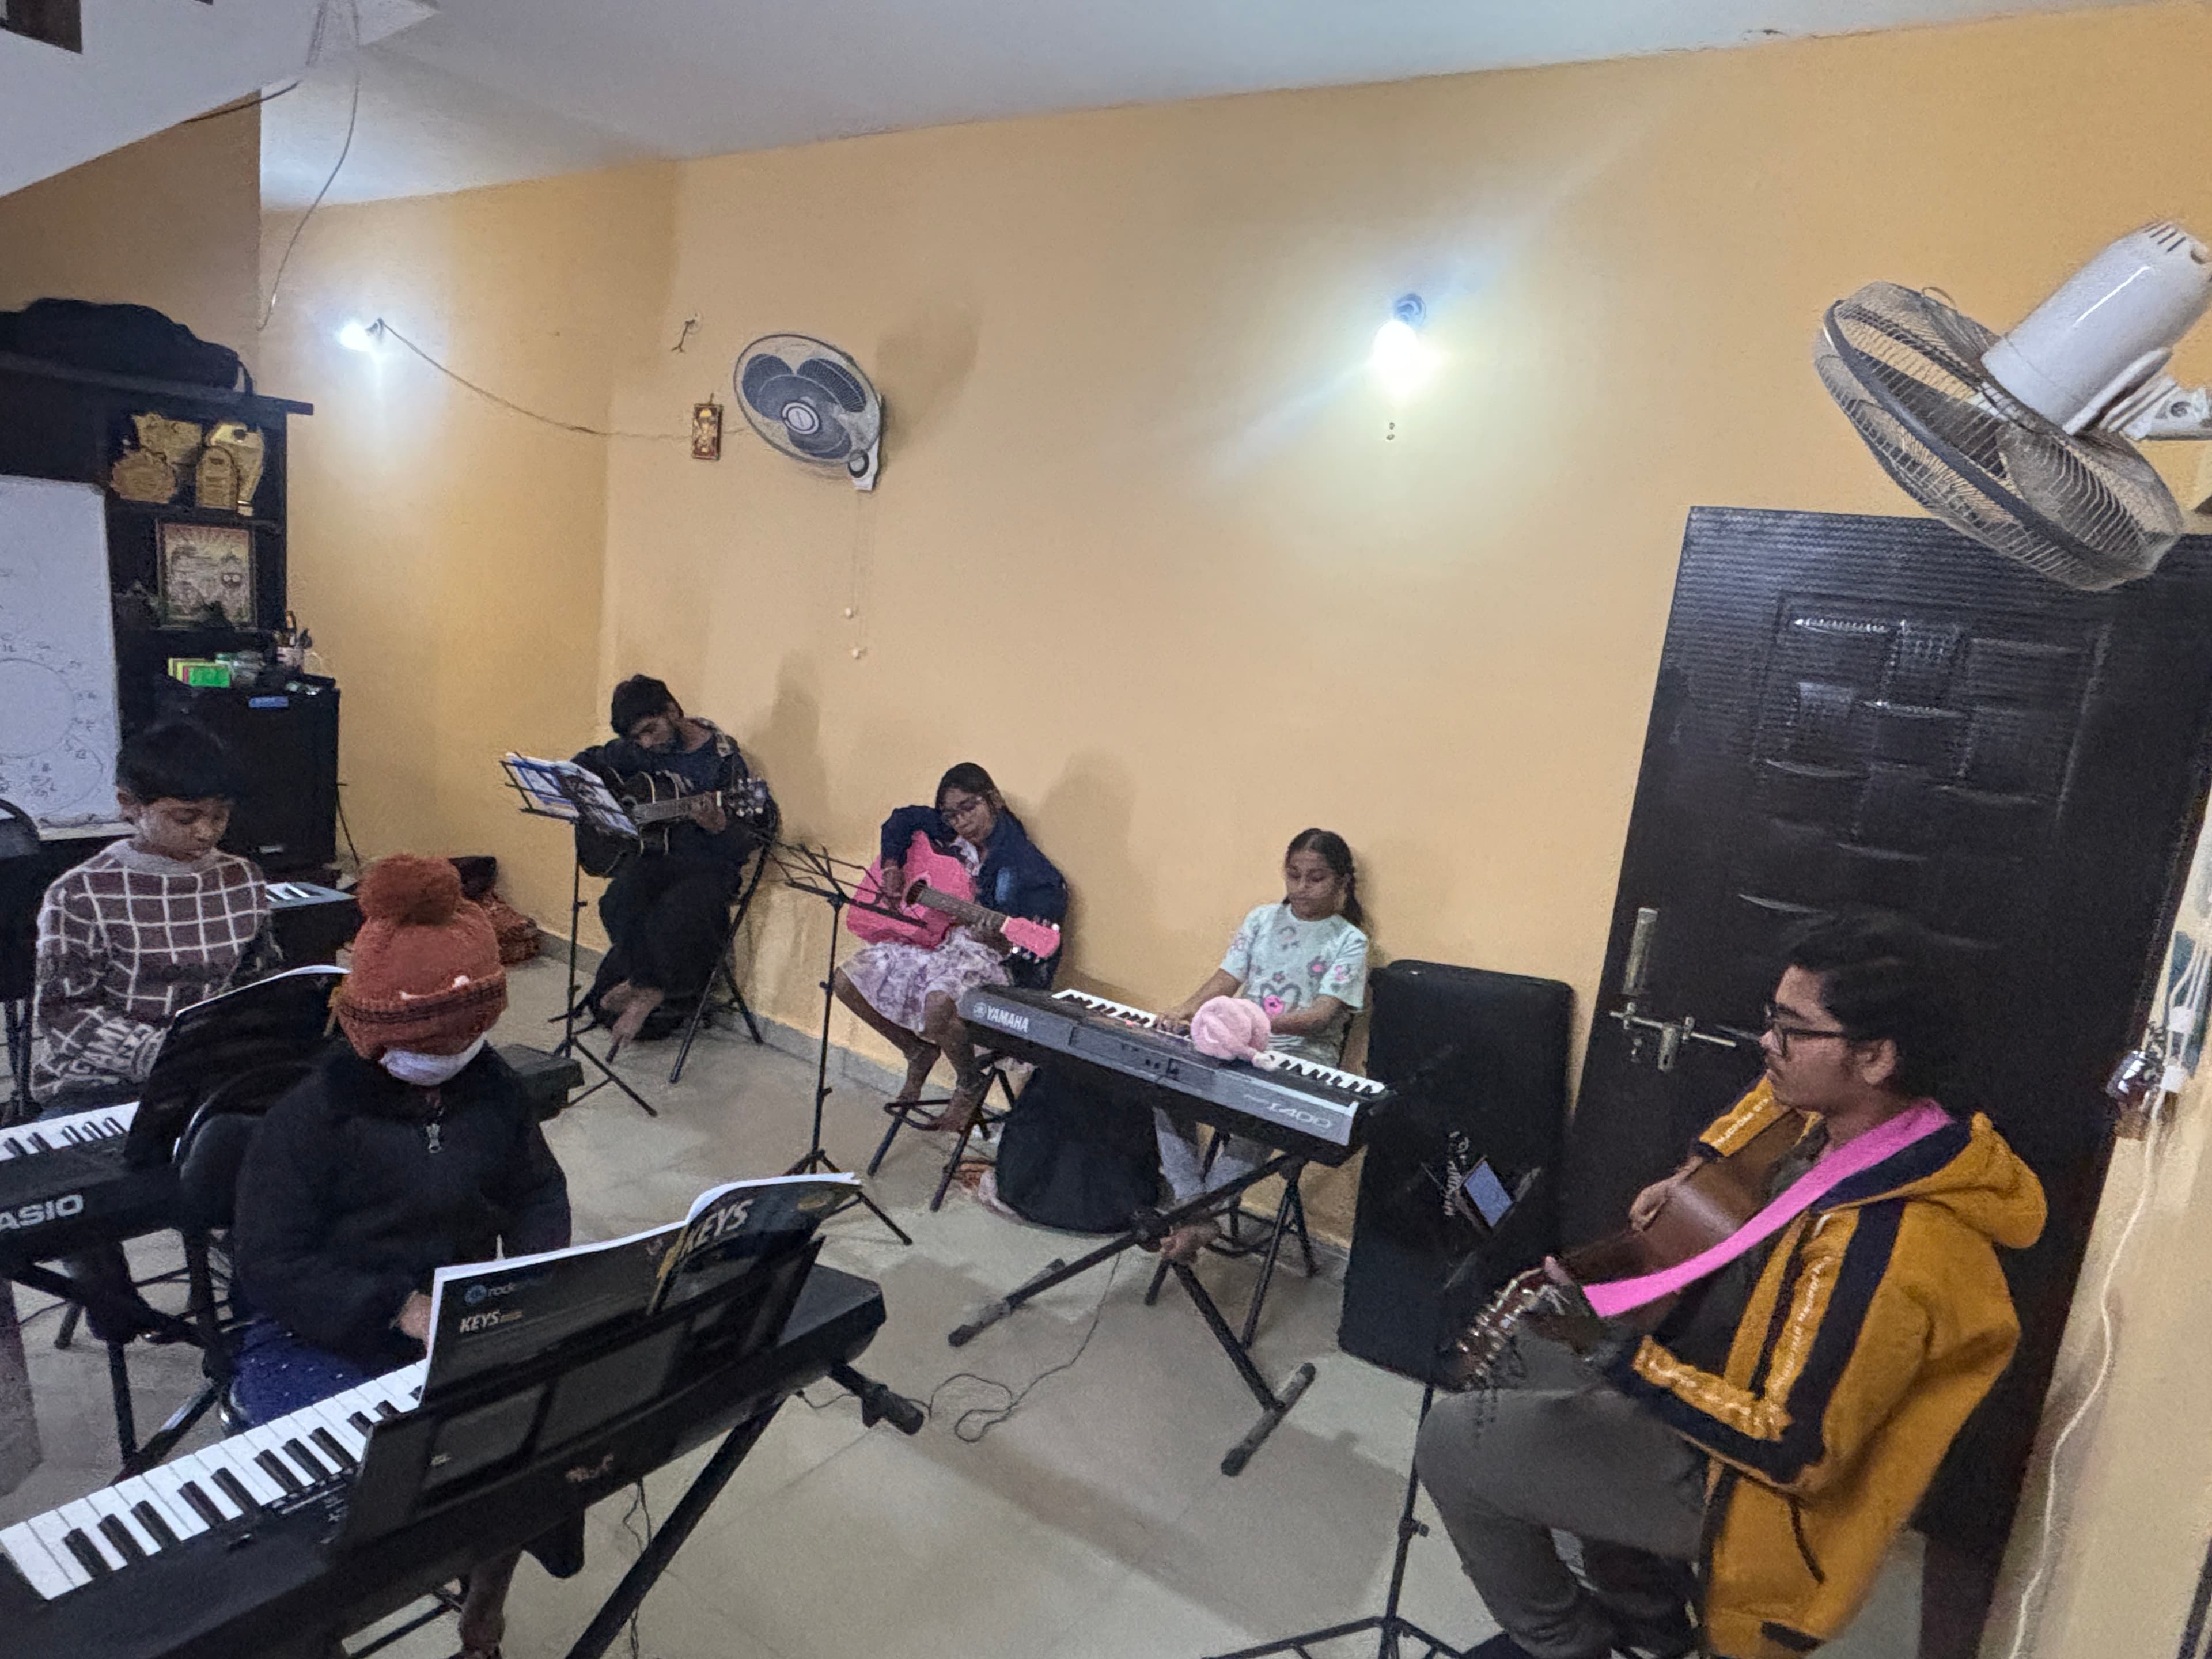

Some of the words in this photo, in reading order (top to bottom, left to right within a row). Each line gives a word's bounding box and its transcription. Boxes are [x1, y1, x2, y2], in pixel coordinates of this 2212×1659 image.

[987, 1005, 1029, 1033] YAMAHA
[0, 1195, 84, 1231] ASIO
[460, 1309, 501, 1332] KEYS
